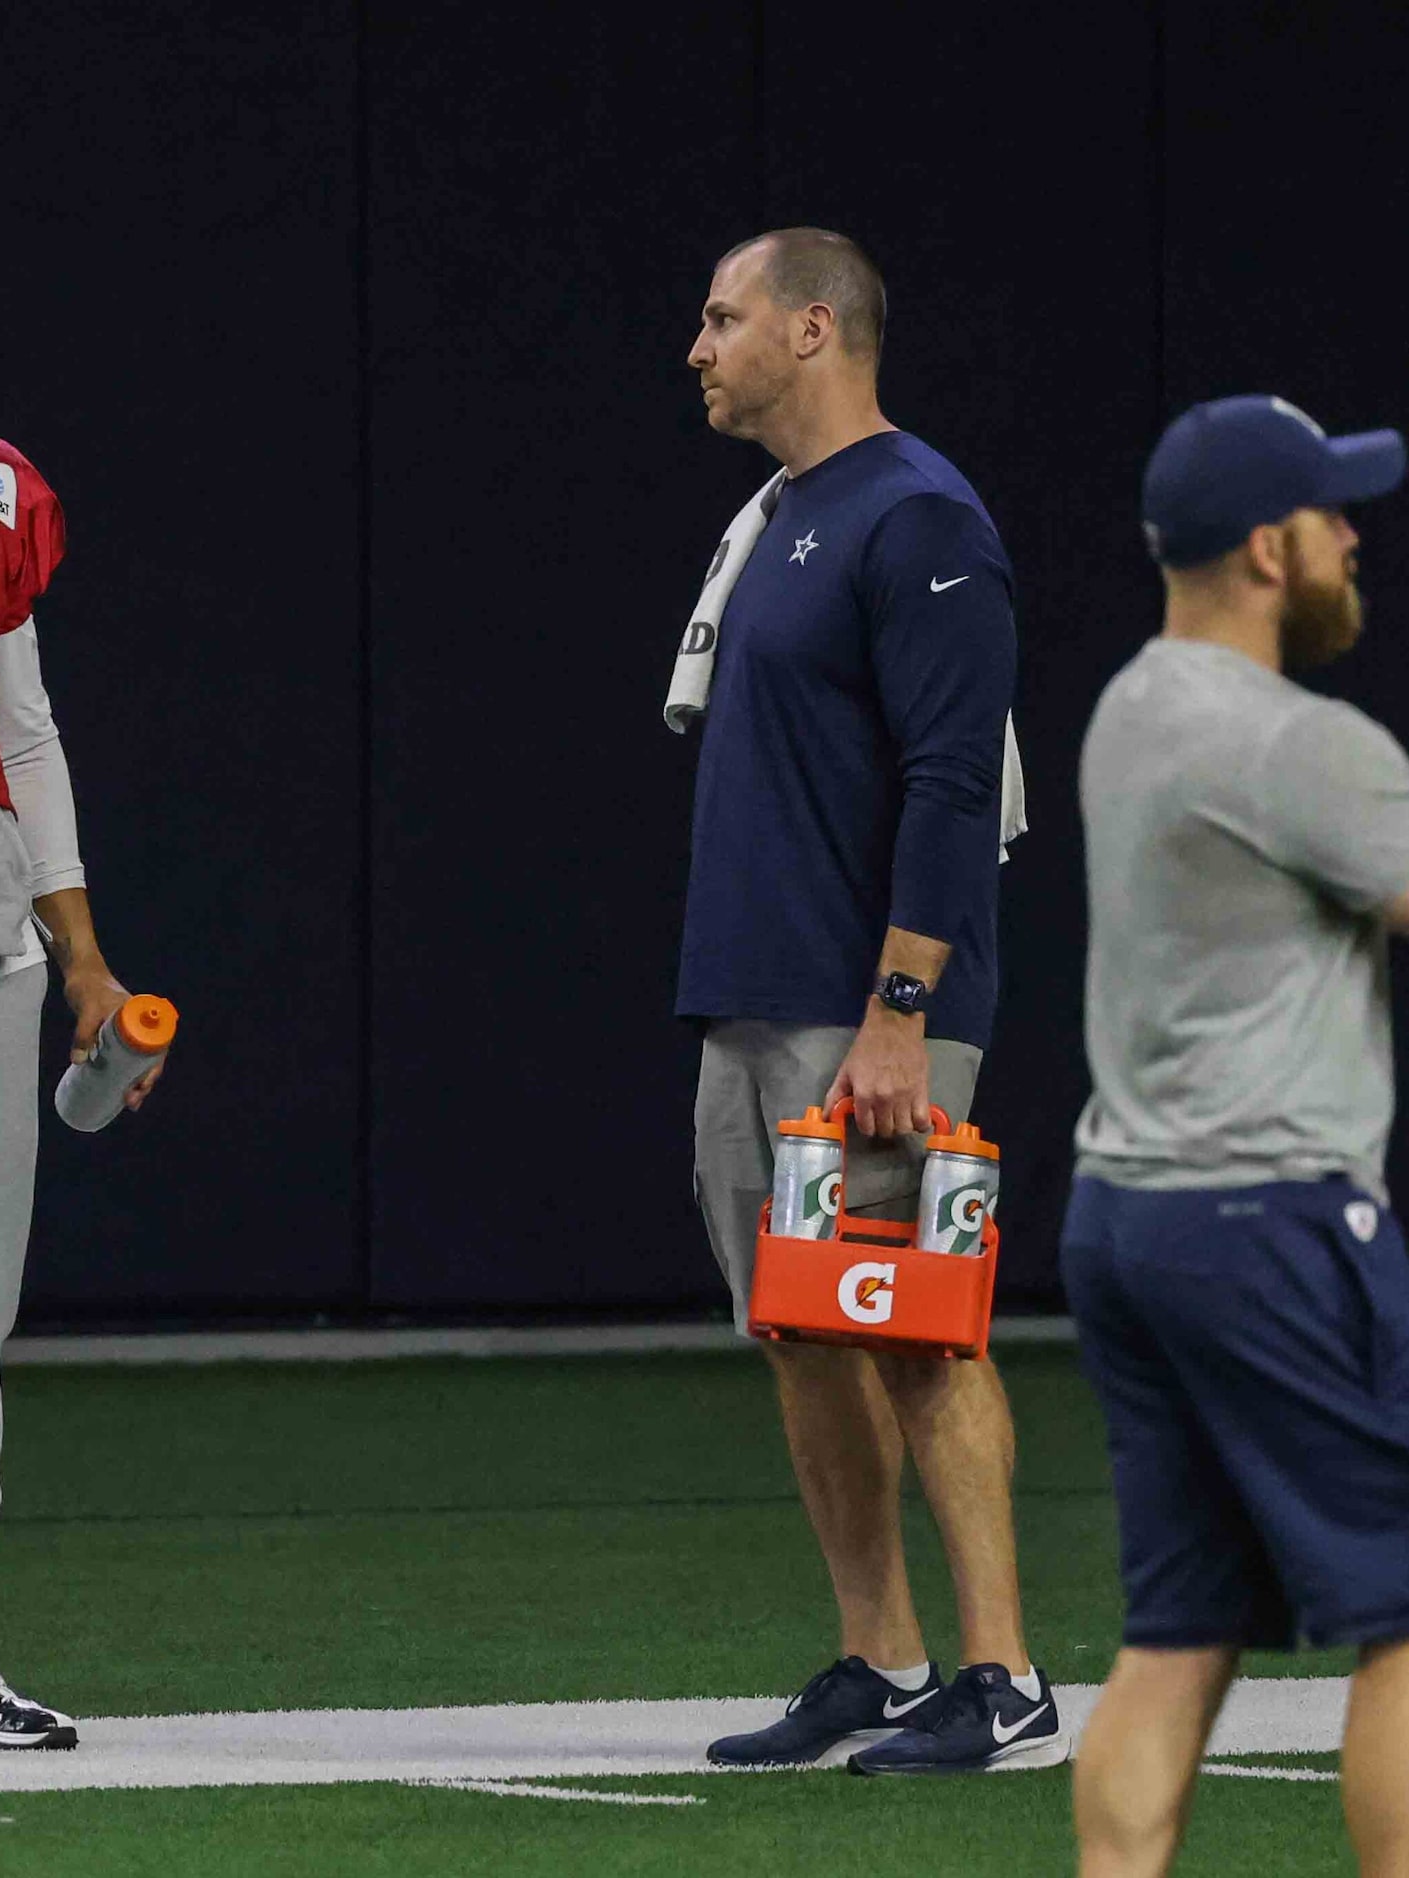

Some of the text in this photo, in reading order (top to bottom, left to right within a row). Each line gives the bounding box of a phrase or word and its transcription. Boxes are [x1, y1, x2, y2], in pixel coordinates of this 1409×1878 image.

[679, 621, 715, 656] D
[950, 1188, 986, 1233] G
[837, 1261, 898, 1325] G
